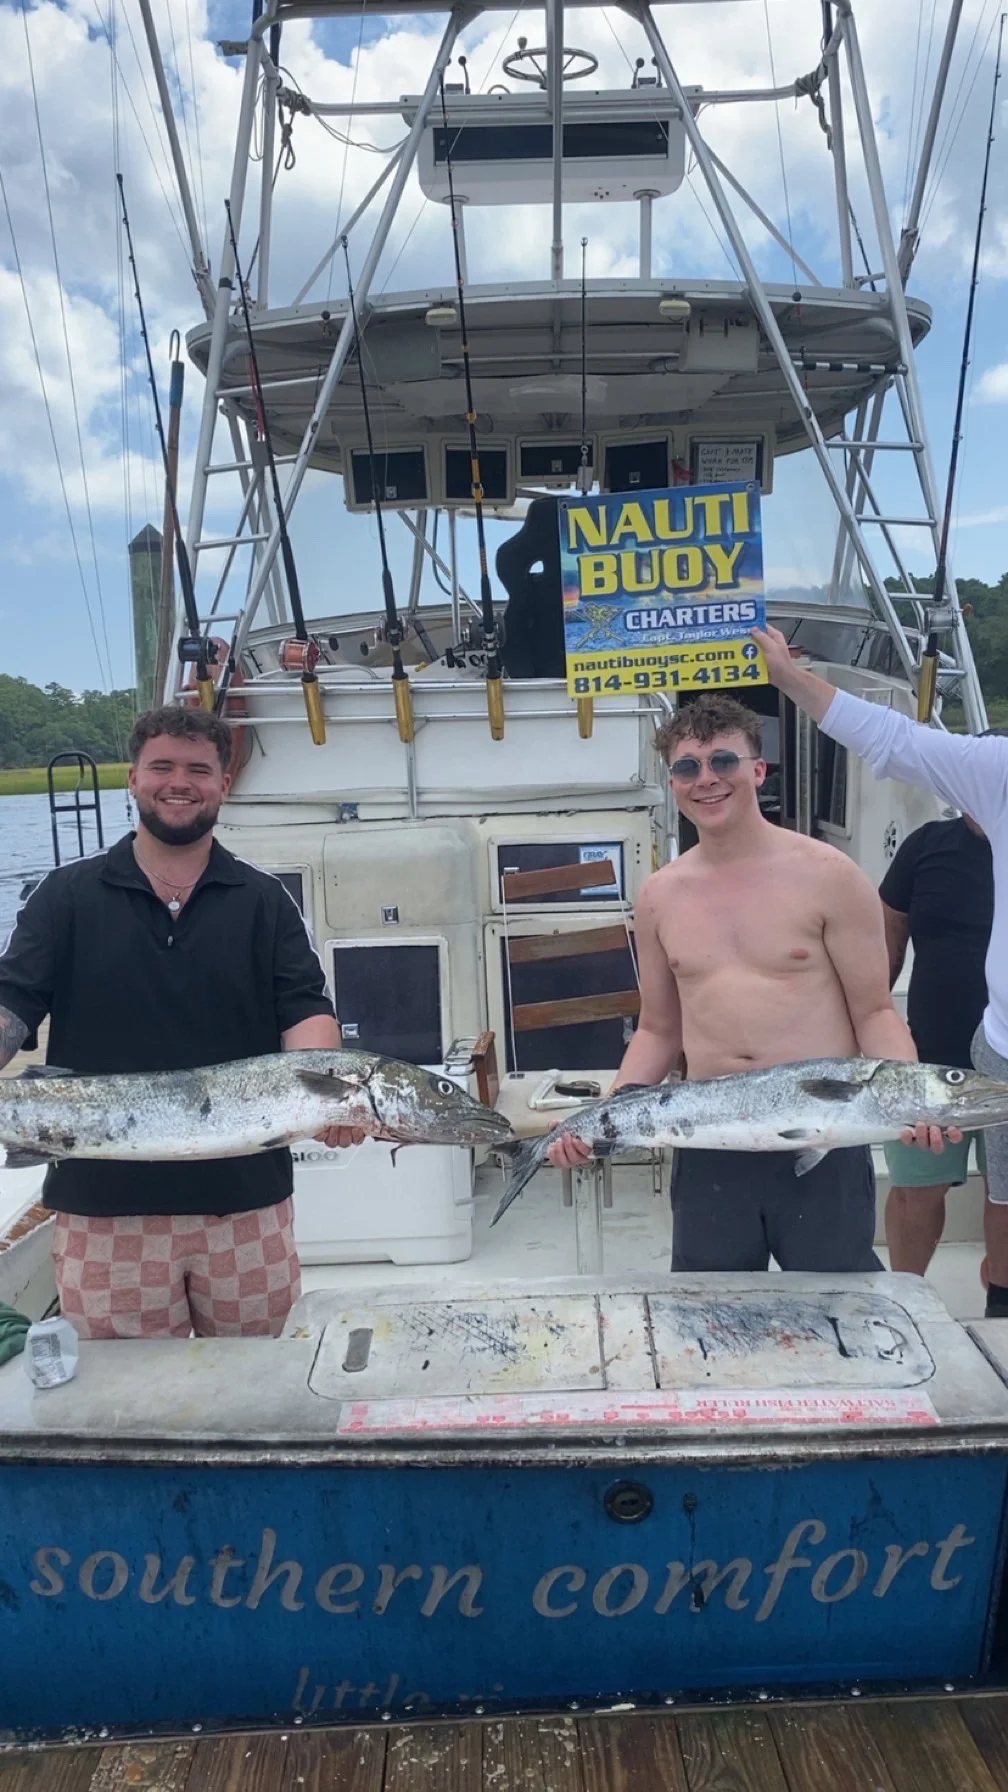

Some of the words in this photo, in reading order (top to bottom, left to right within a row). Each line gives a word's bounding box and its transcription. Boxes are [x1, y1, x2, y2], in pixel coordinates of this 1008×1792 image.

[567, 491, 750, 549] NAUTI
[579, 542, 744, 597] BUOY
[625, 602, 757, 629] CHARTERS
[679, 629, 718, 641] Taylor
[574, 650, 735, 672] nautibuoysc.com
[574, 664, 760, 694] 814-931-4134
[696, 1399, 751, 1408] RULER
[29, 1527, 485, 1618] southern
[531, 1518, 976, 1622] comfort
